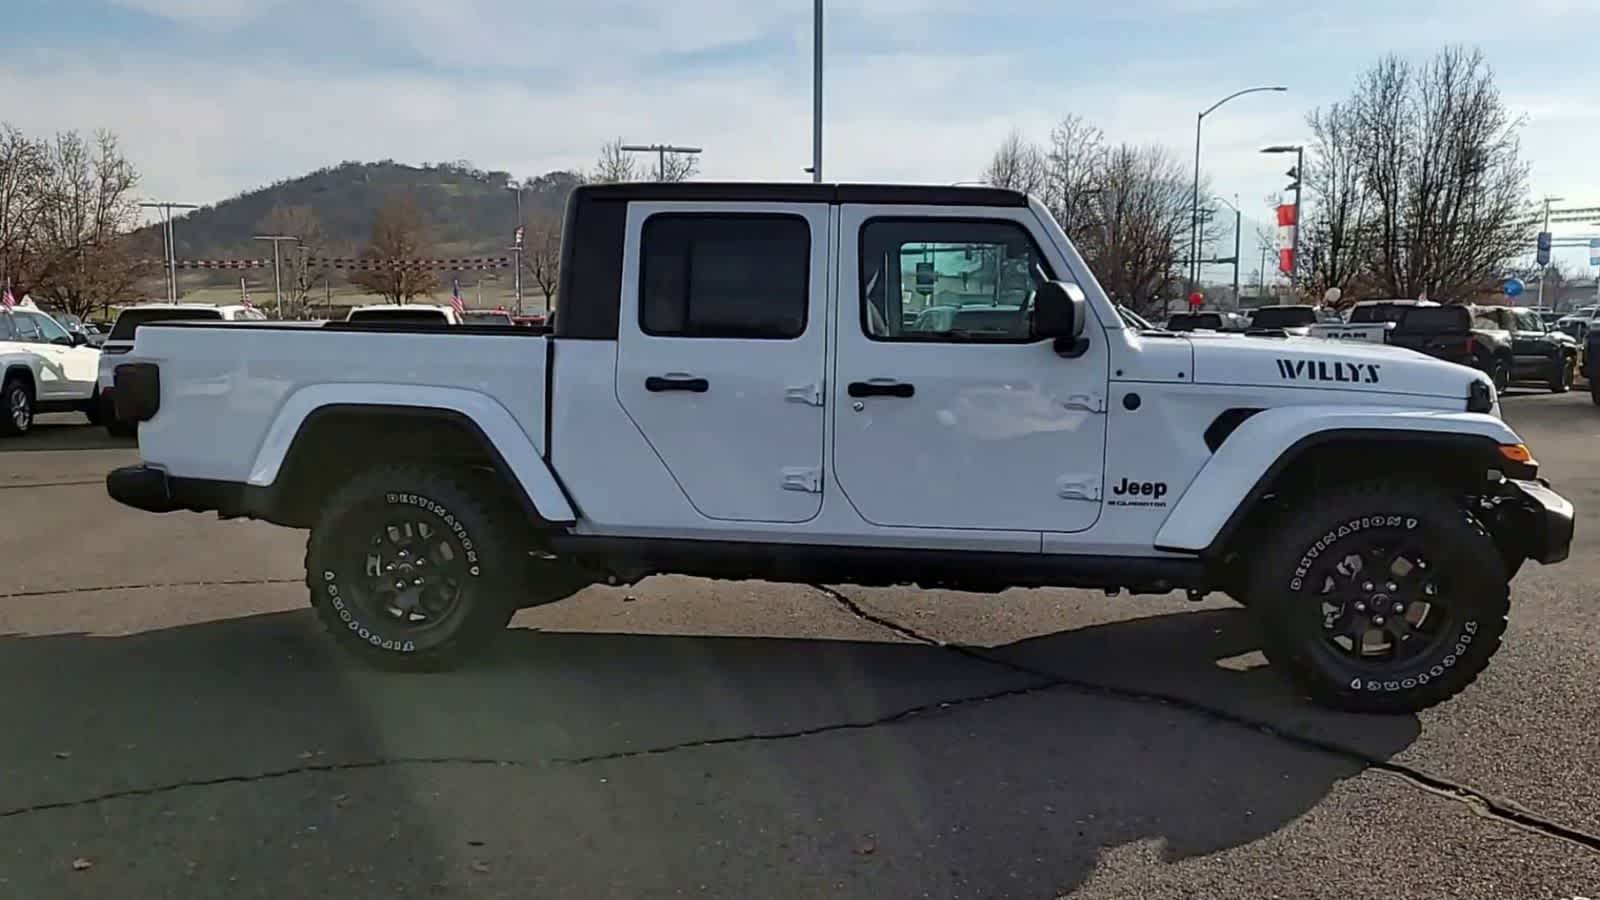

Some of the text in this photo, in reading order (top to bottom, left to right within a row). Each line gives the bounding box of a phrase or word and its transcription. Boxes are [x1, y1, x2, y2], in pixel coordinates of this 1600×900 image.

[1275, 359, 1381, 383] WILLYS
[1113, 477, 1167, 499] Jeep
[387, 493, 478, 562] DESTINATION
[1290, 515, 1402, 590] DESTINATION
